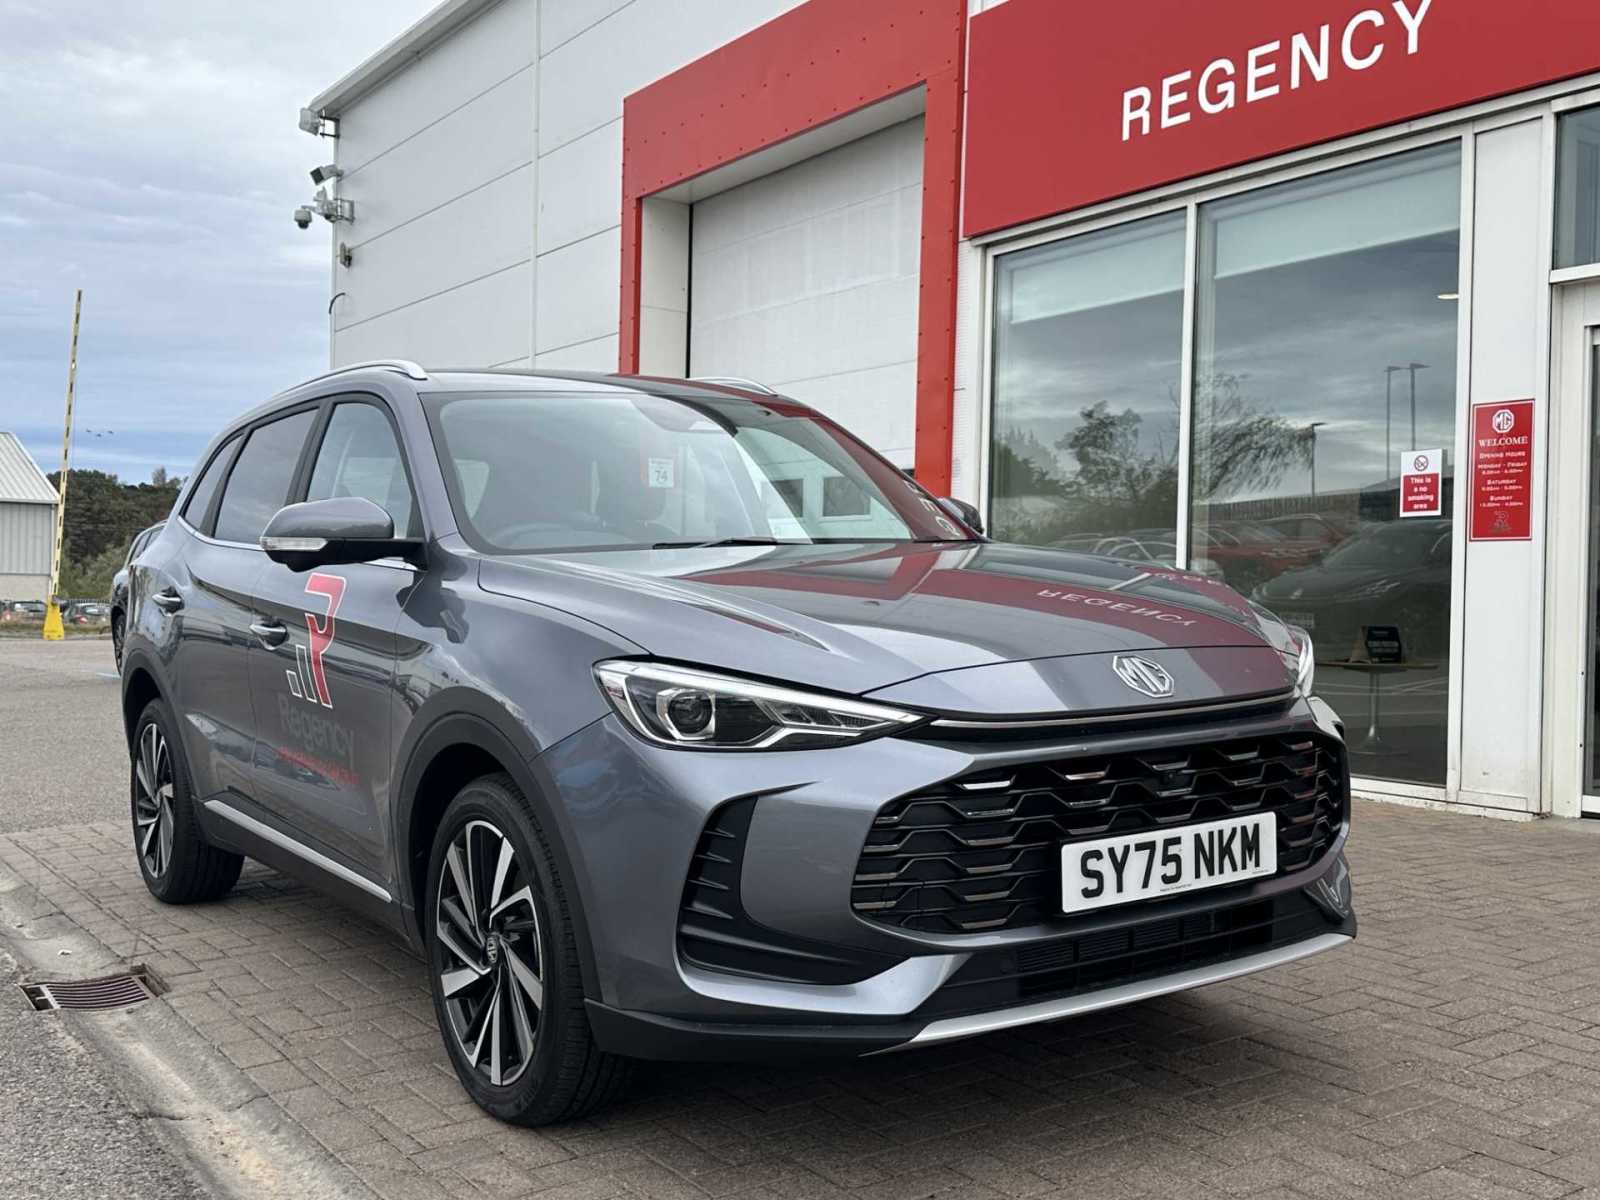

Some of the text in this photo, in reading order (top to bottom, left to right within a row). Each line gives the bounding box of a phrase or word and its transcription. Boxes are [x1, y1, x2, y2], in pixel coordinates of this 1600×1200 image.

[1122, 0, 1431, 141] REGENCY
[1494, 411, 1513, 431] MG
[1478, 436, 1528, 448] WELCOME
[655, 470, 668, 482] 74
[1407, 494, 1434, 502] smoking
[1117, 655, 1171, 694] MG
[277, 692, 355, 770] Regency
[1081, 823, 1260, 899] SY75 NKM
